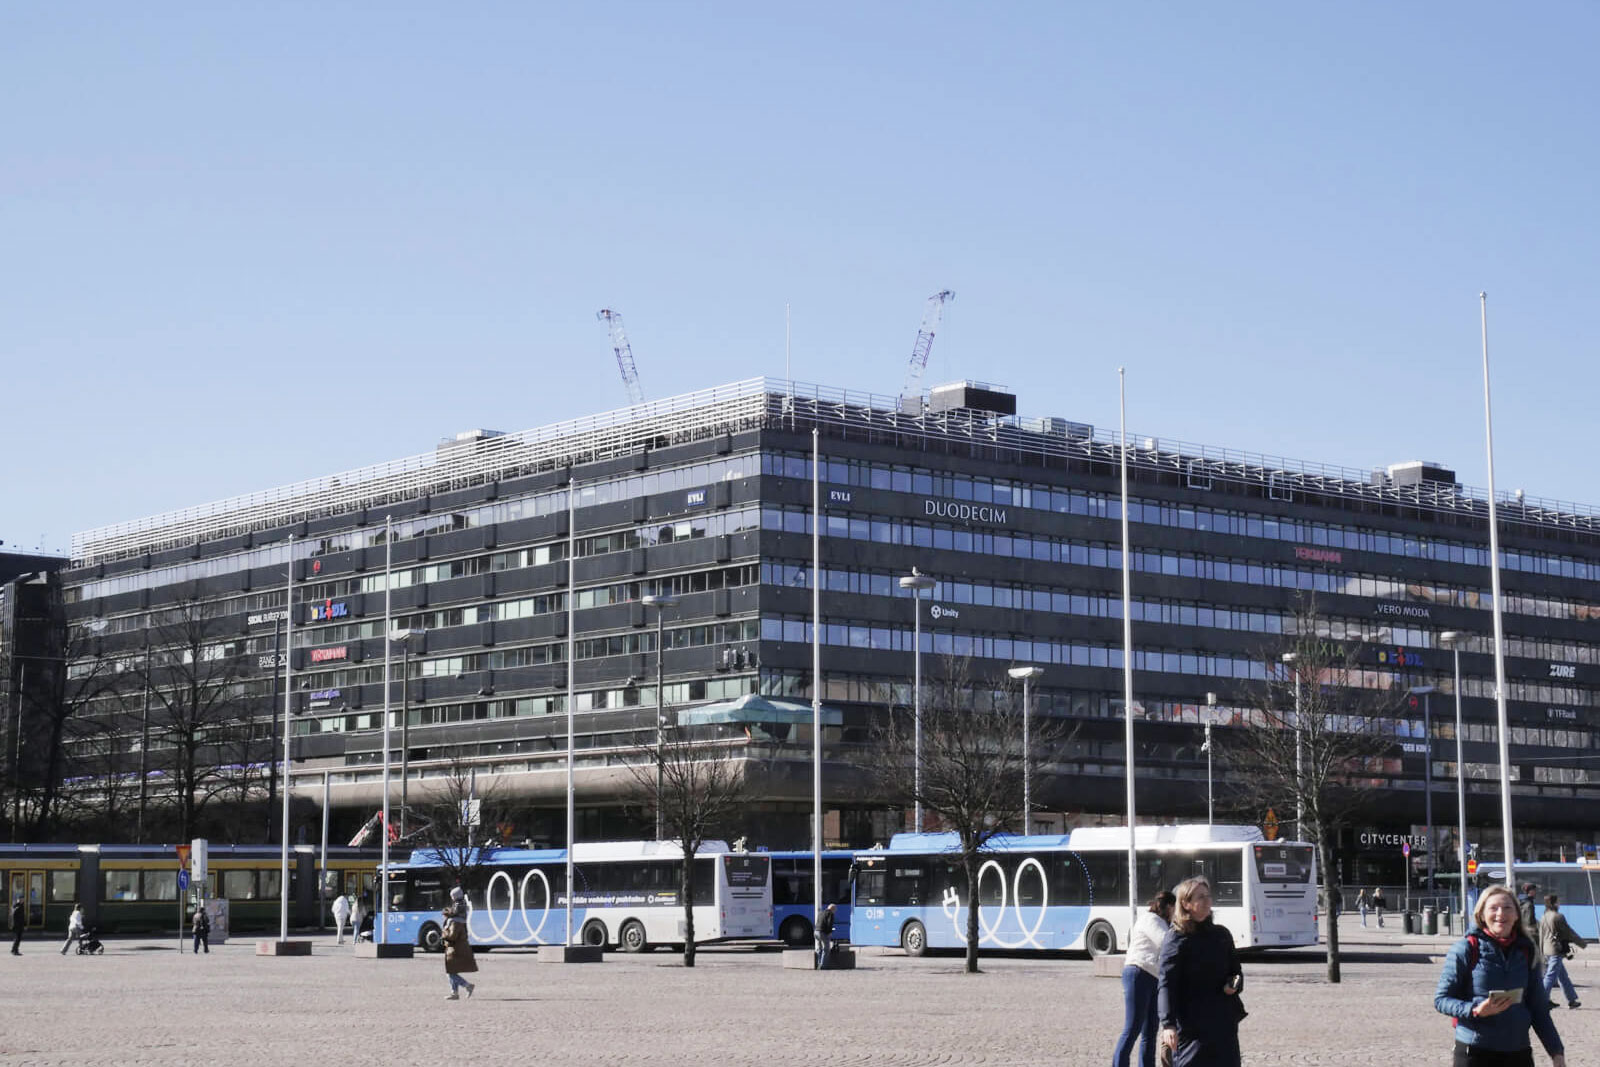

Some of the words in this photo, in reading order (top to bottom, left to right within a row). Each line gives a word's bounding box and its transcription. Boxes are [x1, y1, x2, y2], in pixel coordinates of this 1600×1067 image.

[831, 490, 850, 502] EVLI
[925, 499, 1006, 524] DUODECIM
[942, 608, 960, 619] Unity
[1377, 603, 1401, 615] VERO
[1402, 606, 1430, 618] MODA
[1360, 833, 1428, 846] CITYCENTER
